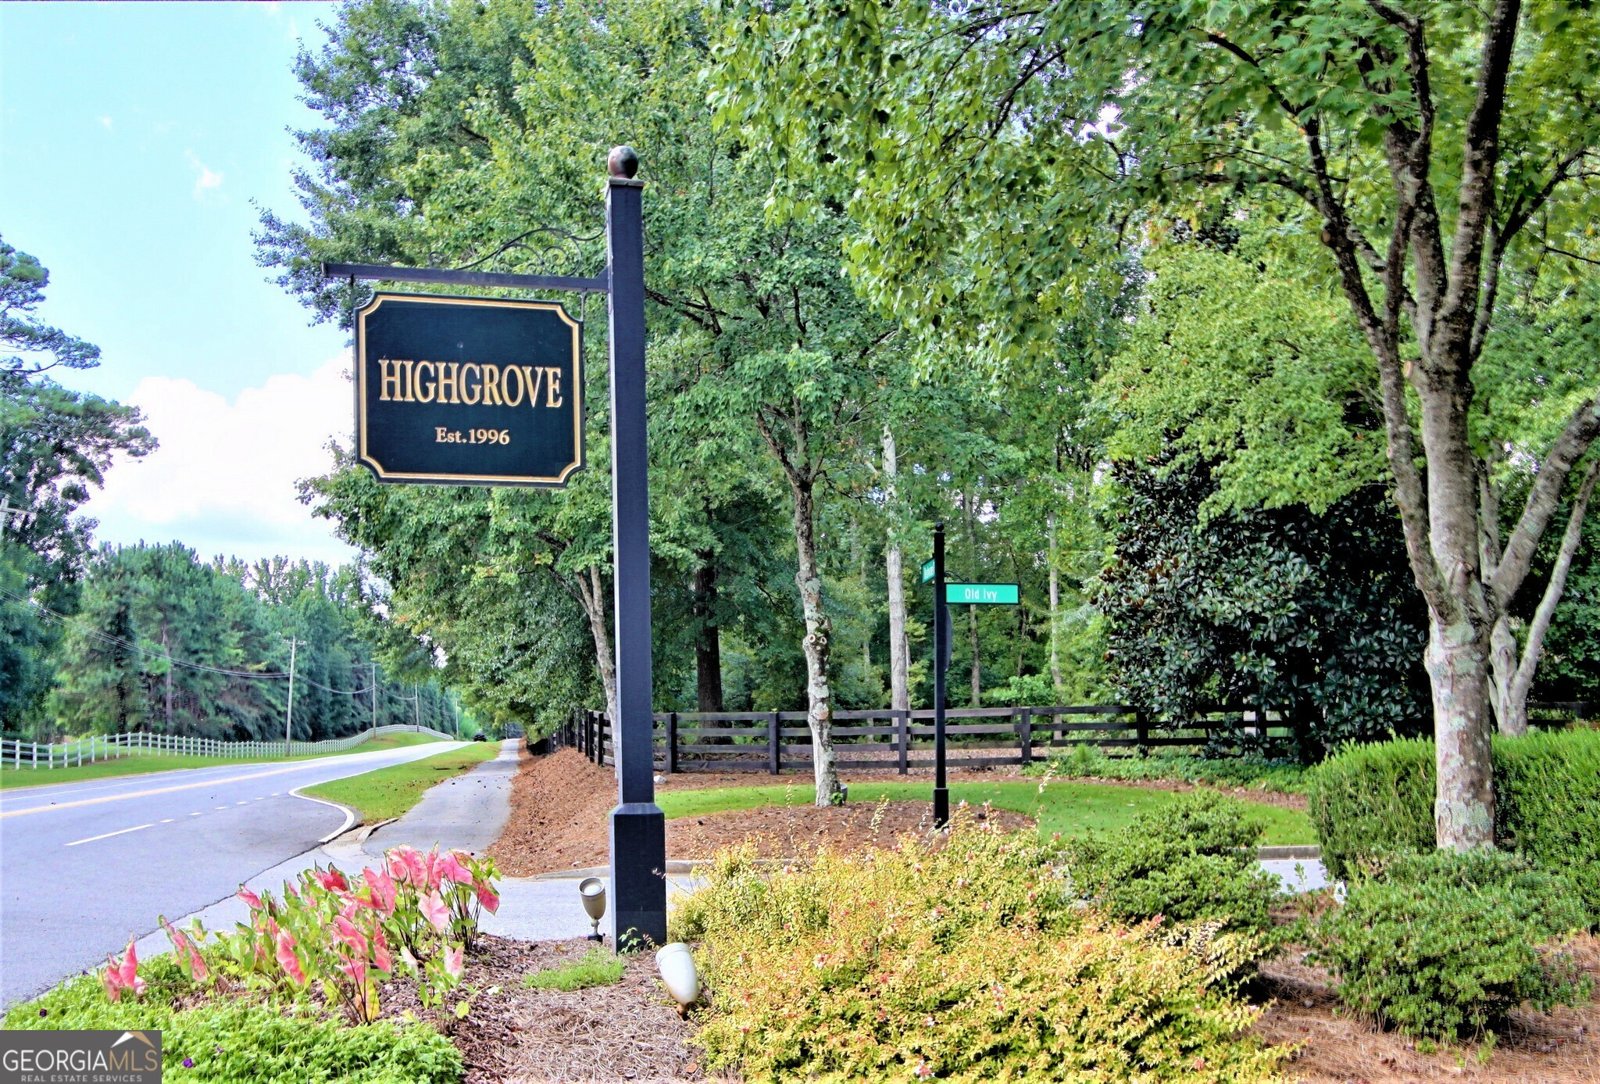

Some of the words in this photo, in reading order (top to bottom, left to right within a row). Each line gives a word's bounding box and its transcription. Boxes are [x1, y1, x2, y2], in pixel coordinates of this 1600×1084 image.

[378, 359, 563, 408] HIGHGROVE
[435, 427, 510, 445] Est.1996
[964, 588, 980, 600] Old
[983, 588, 998, 602] Ivy
